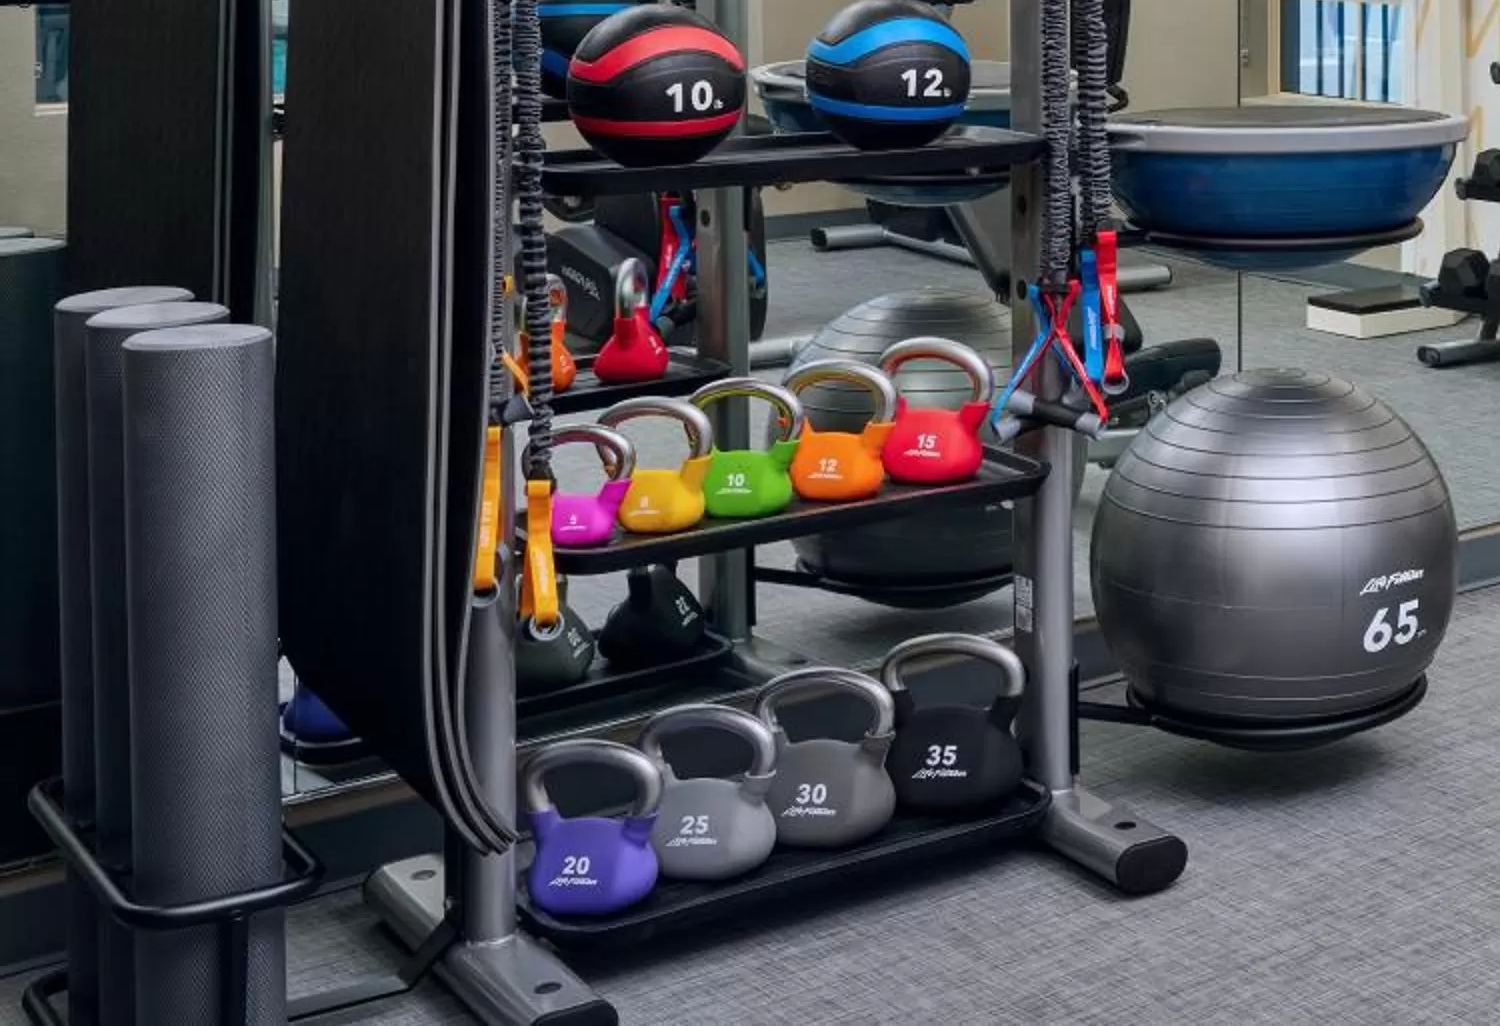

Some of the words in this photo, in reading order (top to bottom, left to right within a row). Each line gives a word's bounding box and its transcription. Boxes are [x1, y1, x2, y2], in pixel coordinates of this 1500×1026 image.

[901, 69, 943, 97] 12
[665, 80, 713, 113] 10
[917, 433, 938, 449] 15
[820, 458, 838, 473] 12
[726, 473, 745, 487] 10
[1363, 599, 1419, 653] 65
[926, 745, 957, 766] 35
[796, 784, 827, 805] 30
[680, 815, 709, 835] 25
[562, 856, 590, 875] 20
